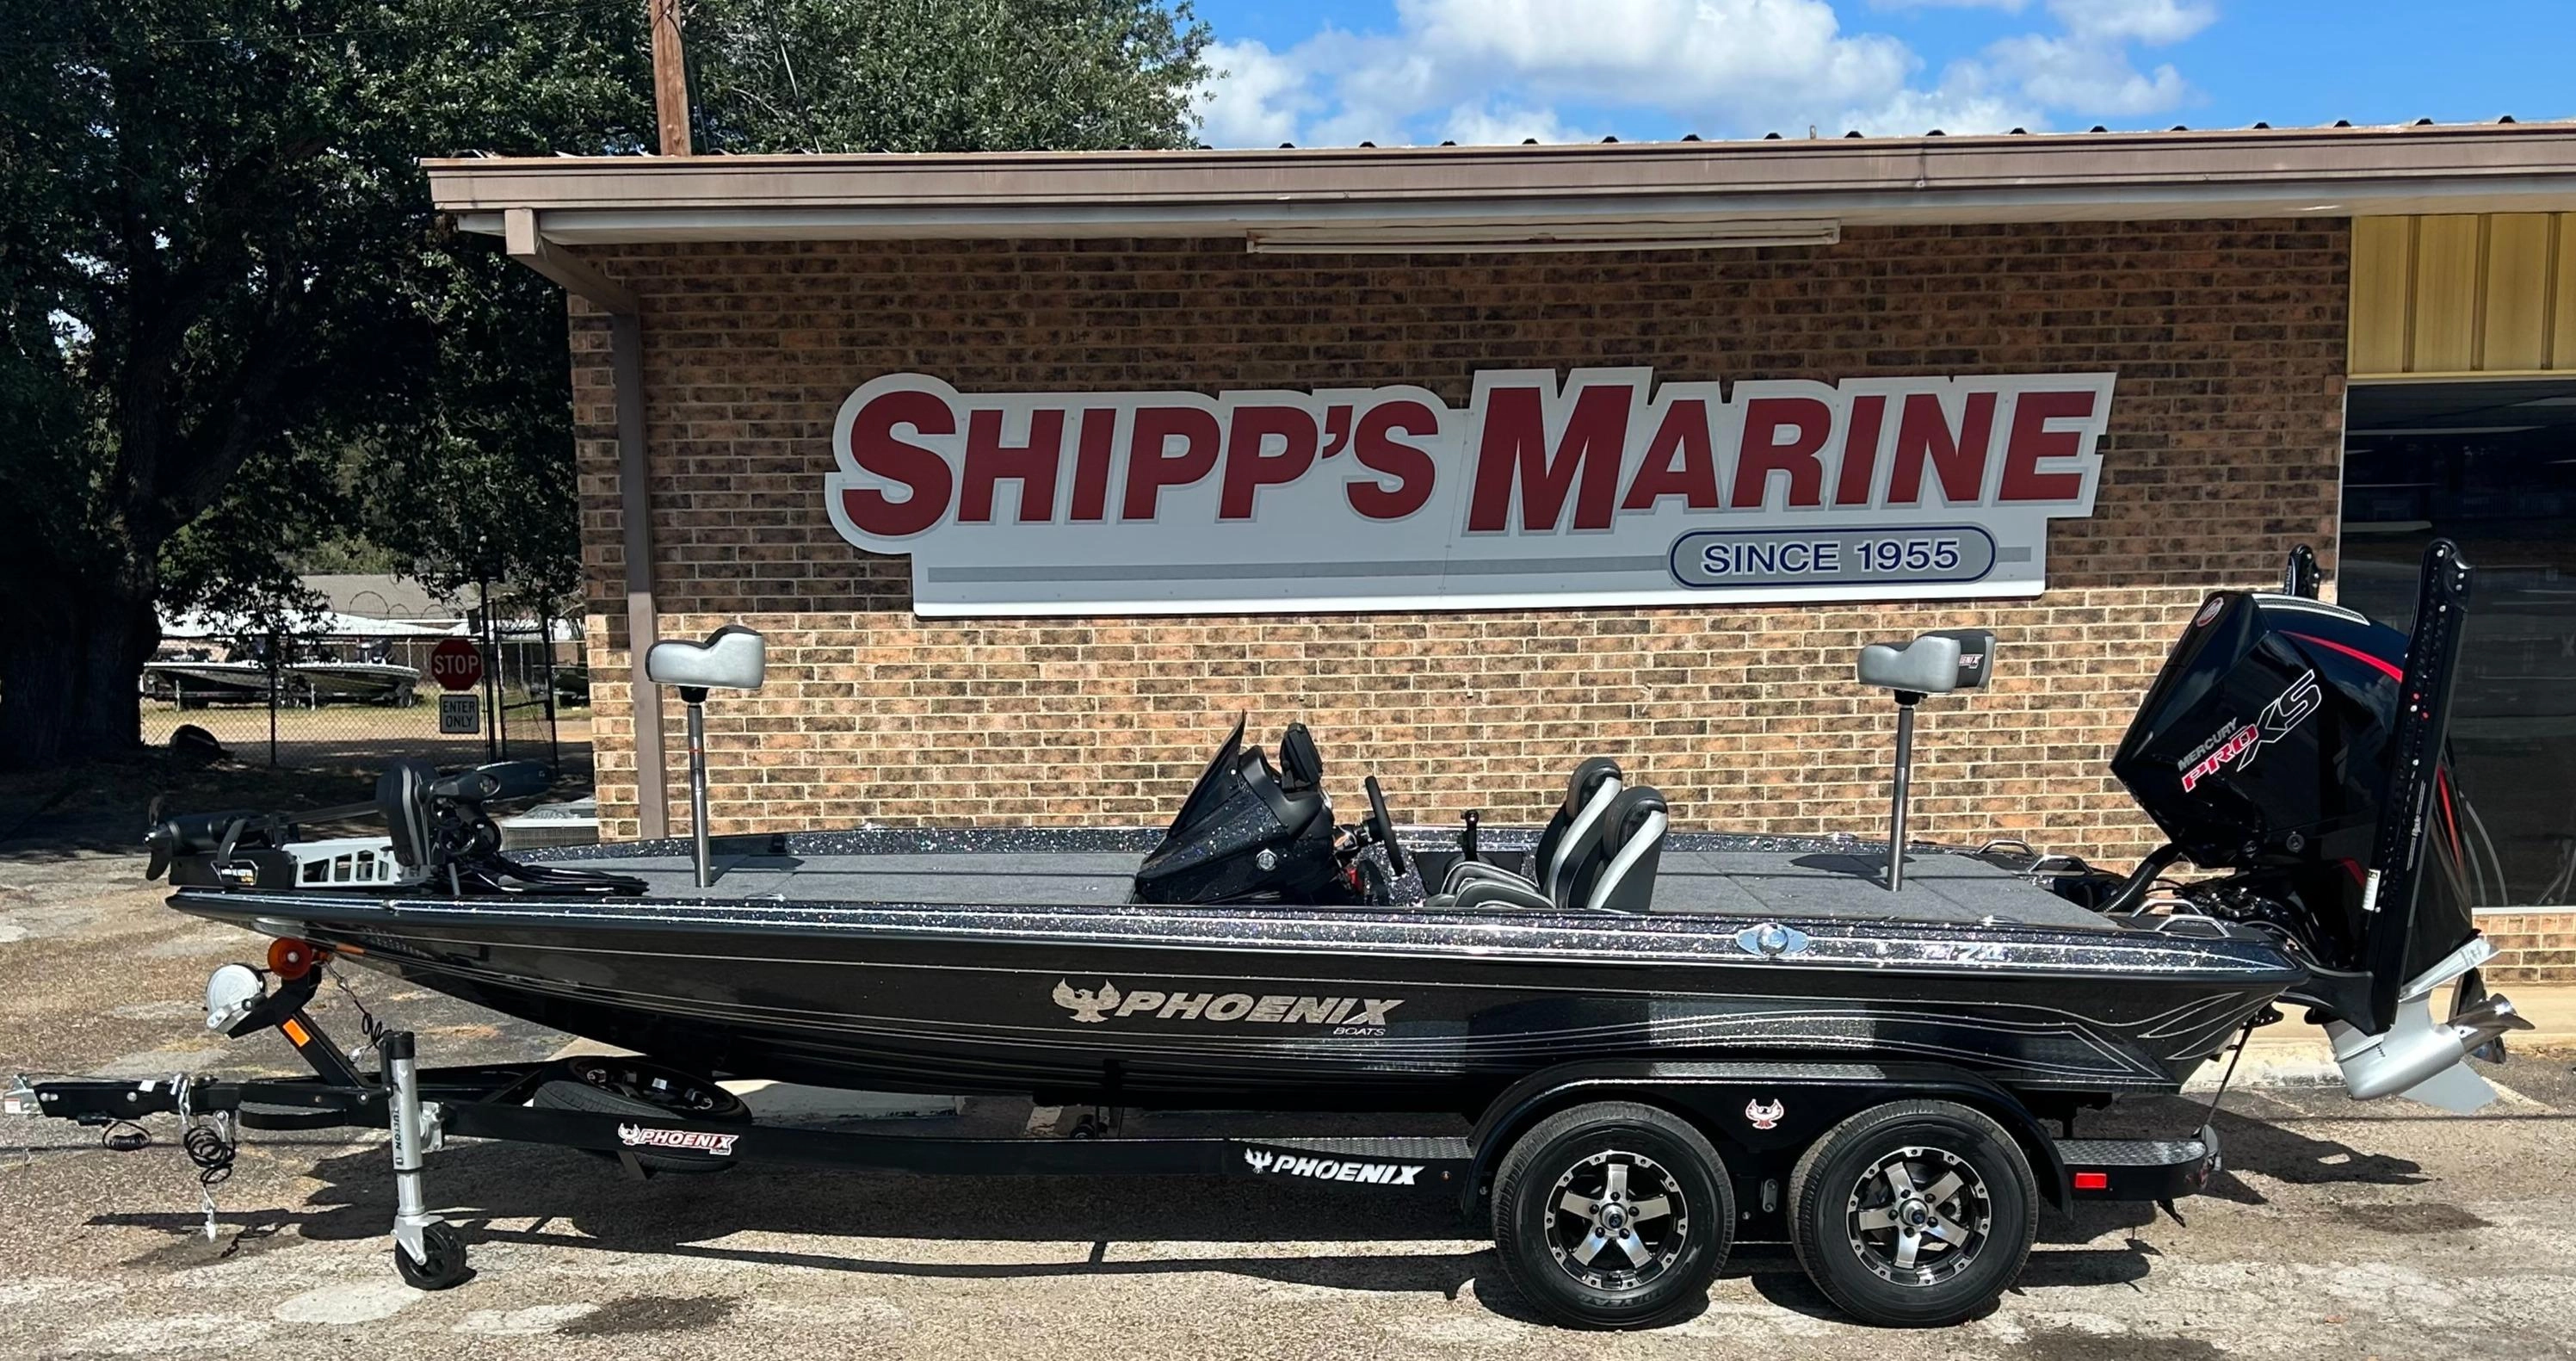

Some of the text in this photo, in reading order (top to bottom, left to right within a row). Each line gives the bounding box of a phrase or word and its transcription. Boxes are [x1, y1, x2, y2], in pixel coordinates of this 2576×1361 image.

[842, 384, 2096, 536] SHIPP'S MARINE
[1702, 537, 1961, 576] SINCE 1955
[434, 654, 479, 675] STOP
[442, 701, 475, 714] ENTER
[446, 715, 473, 728] ONLY
[2177, 717, 2238, 771] MERCURY
[1114, 990, 1405, 1025] PHOENIX
[1333, 1027, 1386, 1036] BOATS
[638, 1129, 738, 1149] PHOENIX
[1273, 1152, 1425, 1186] PHOENIX
